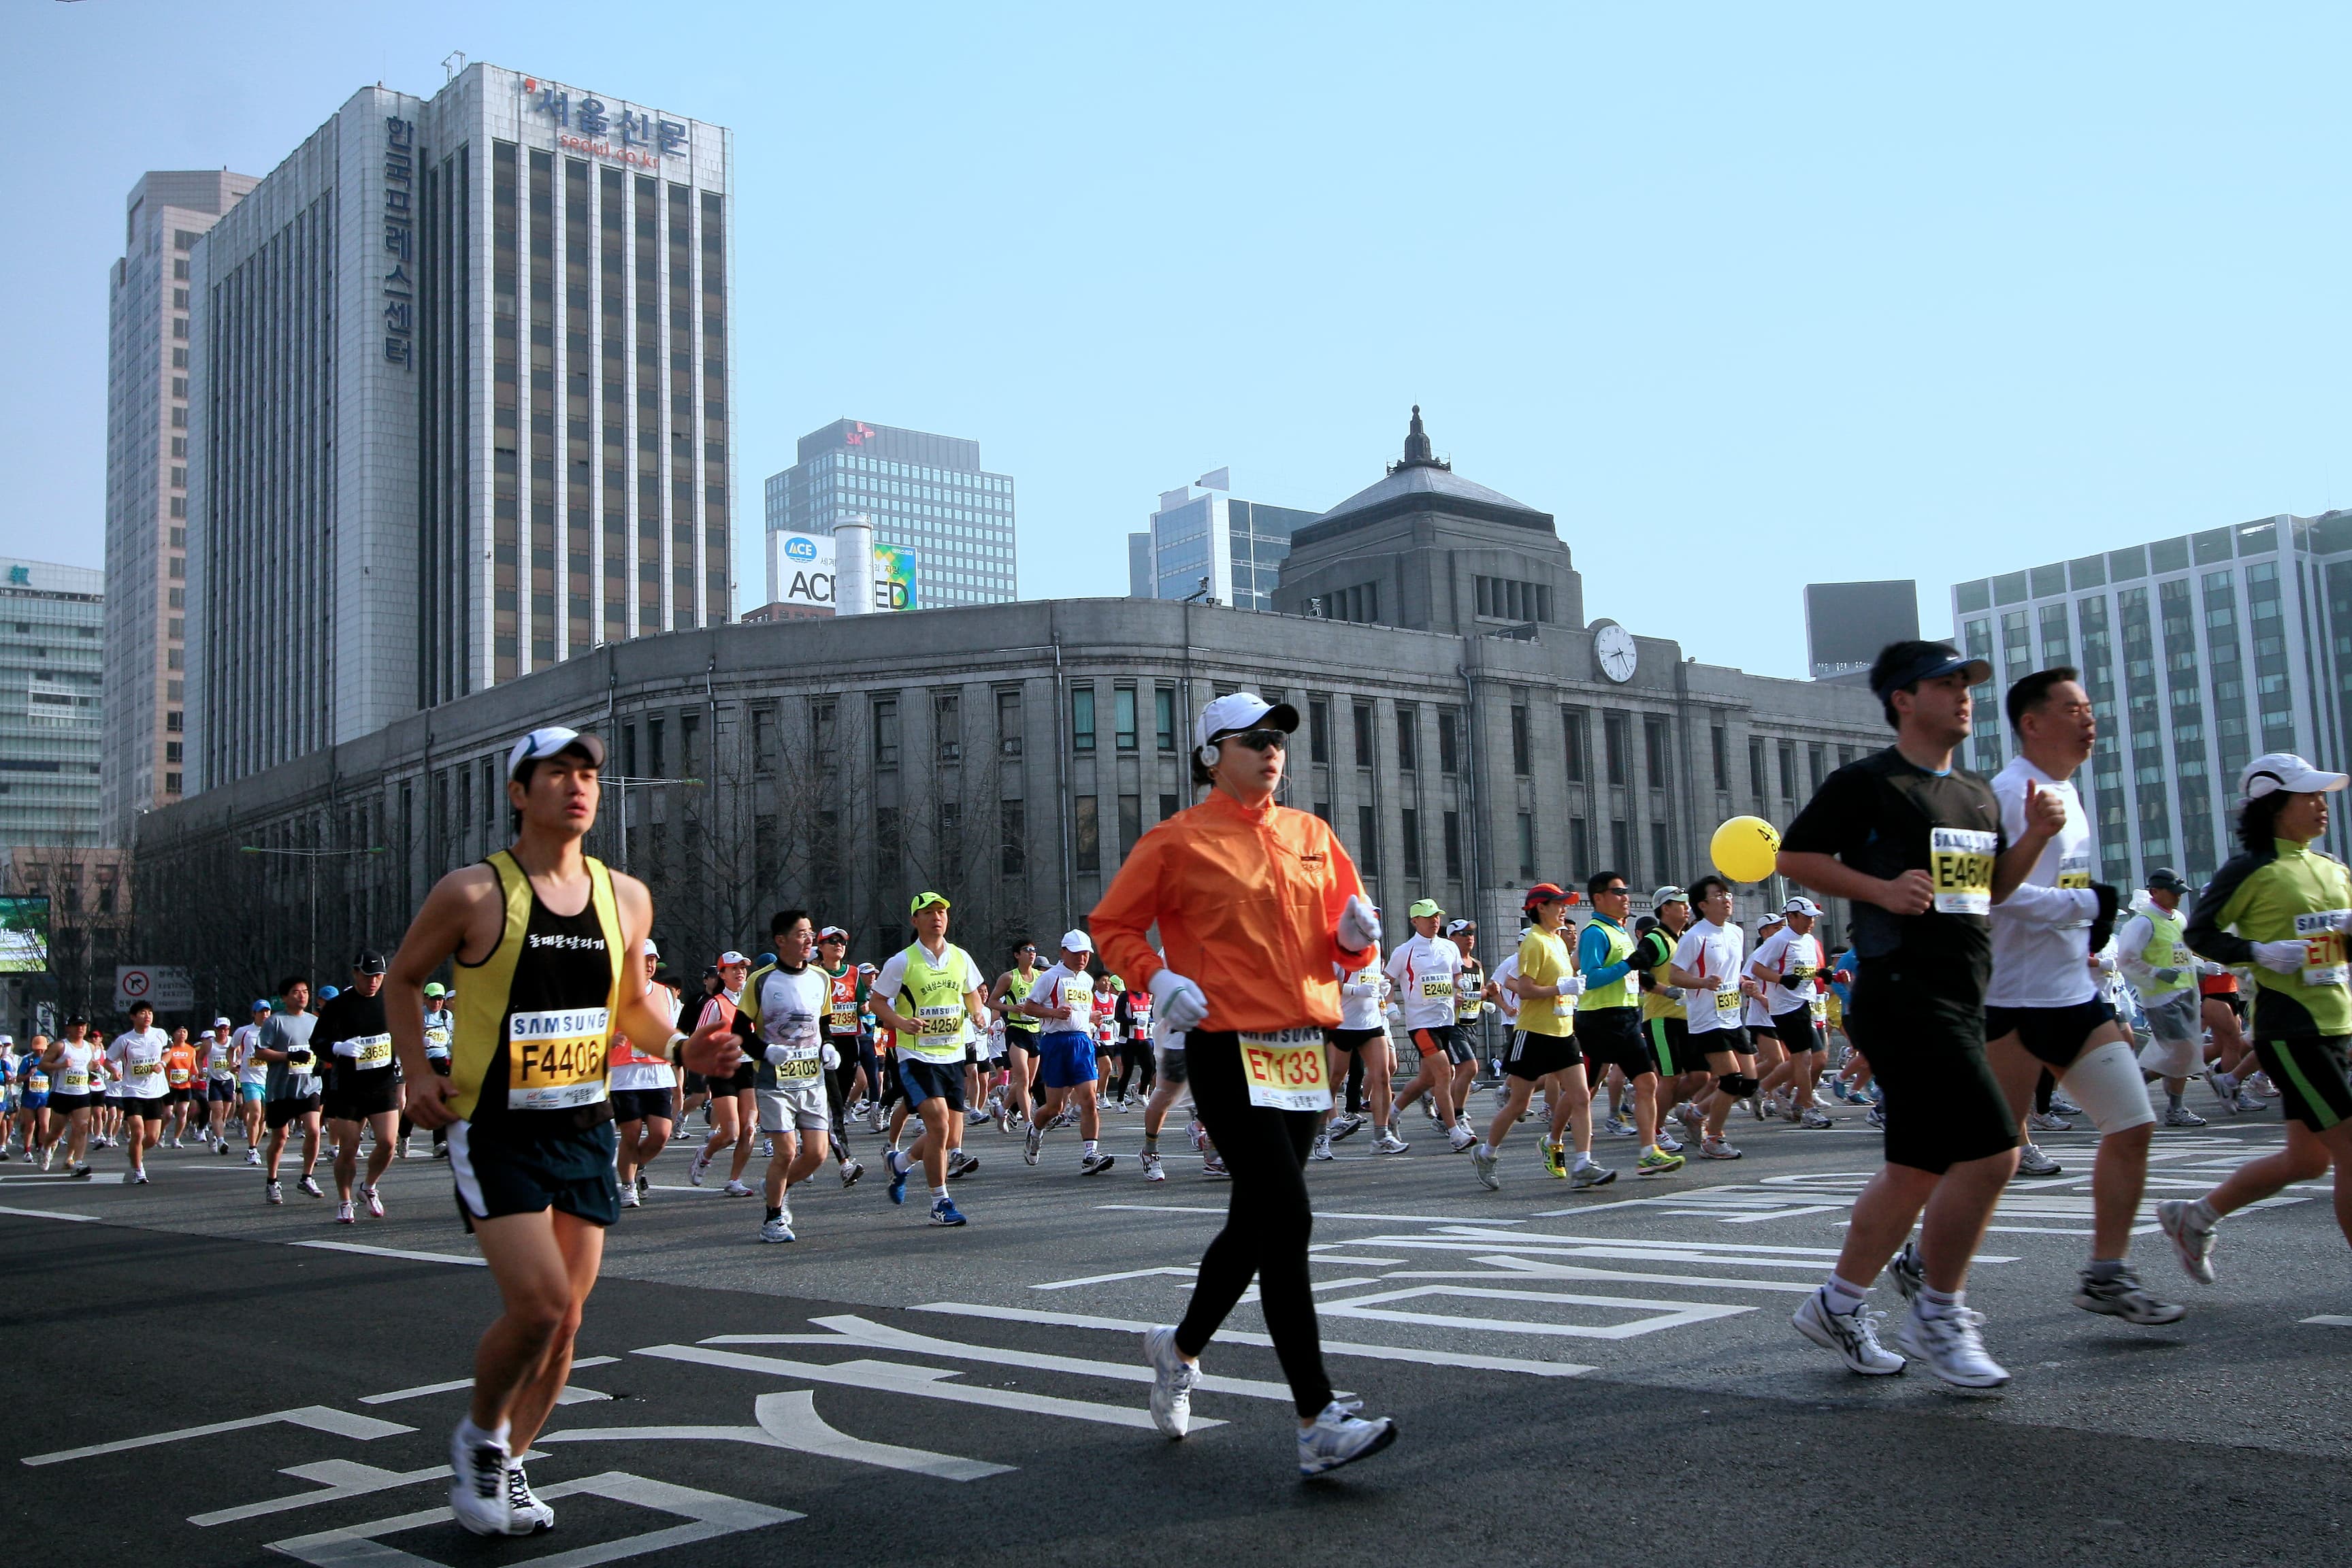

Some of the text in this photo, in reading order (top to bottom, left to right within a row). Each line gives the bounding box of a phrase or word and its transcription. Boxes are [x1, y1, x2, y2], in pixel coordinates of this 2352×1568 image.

[536, 88, 689, 158] 서울신문
[560, 134, 660, 169] seoul.co.kr
[384, 114, 414, 372] 한국프레스센터
[846, 432, 864, 446] SK
[788, 542, 813, 556] ACE
[875, 580, 910, 610] ED
[1424, 983, 1452, 996] E2400
[919, 1006, 960, 1016] SAMSUNG
[514, 1013, 608, 1035] SAMSUNG
[922, 1017, 958, 1034] E4252
[521, 1040, 600, 1081] F4406
[780, 1060, 818, 1077] E2103
[1246, 1048, 1320, 1085] E7133
